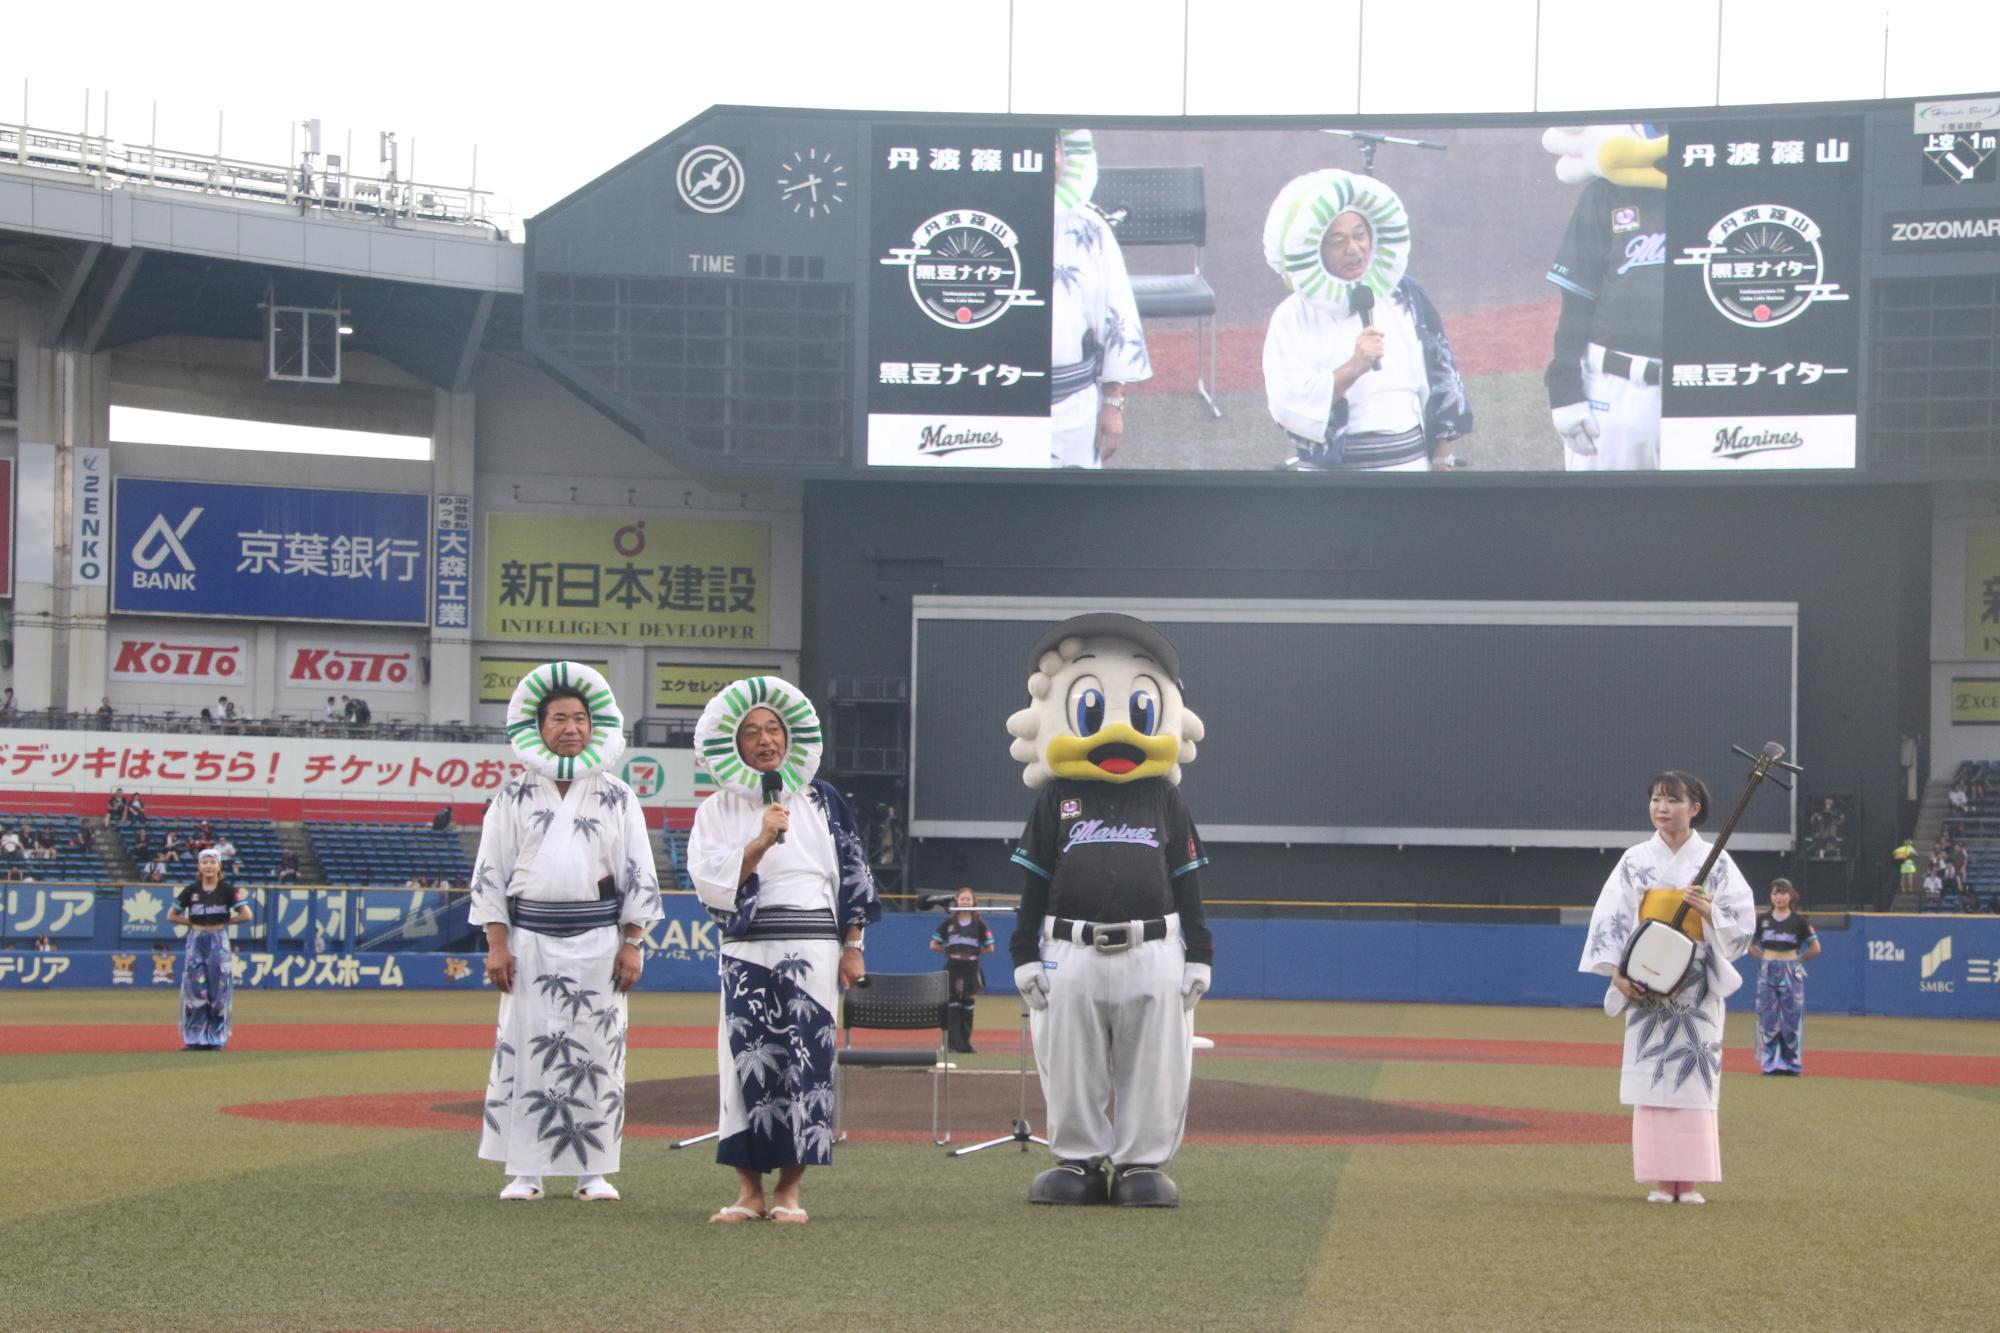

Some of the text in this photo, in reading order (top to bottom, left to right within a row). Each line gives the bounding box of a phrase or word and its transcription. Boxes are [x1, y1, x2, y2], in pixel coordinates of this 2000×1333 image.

[1683, 138, 1849, 168] 丹波篠山
[1924, 133, 1955, 151] 上空
[888, 147, 1043, 173] 丹波篠山
[1891, 218, 2000, 242] ZOZOMAR
[688, 254, 736, 273] TIME
[915, 264, 1015, 281] 黒豆ナイター
[1711, 260, 1817, 279] 黒豆ナイター
[879, 361, 1045, 387] 黒豆ナイター
[1672, 361, 1849, 387] 黒豆ナイター
[917, 424, 1004, 457] Marines
[1711, 425, 1804, 460] Marines
[236, 529, 421, 582] 京葉銀行
[132, 570, 196, 591] BANK
[438, 531, 468, 626] 大森工業
[498, 558, 757, 614] 新日本建設
[501, 617, 755, 640] INTELLIGENT DEVELOPER
[1062, 819, 1160, 853] Marines
[1920, 981, 1954, 993] SMBC
